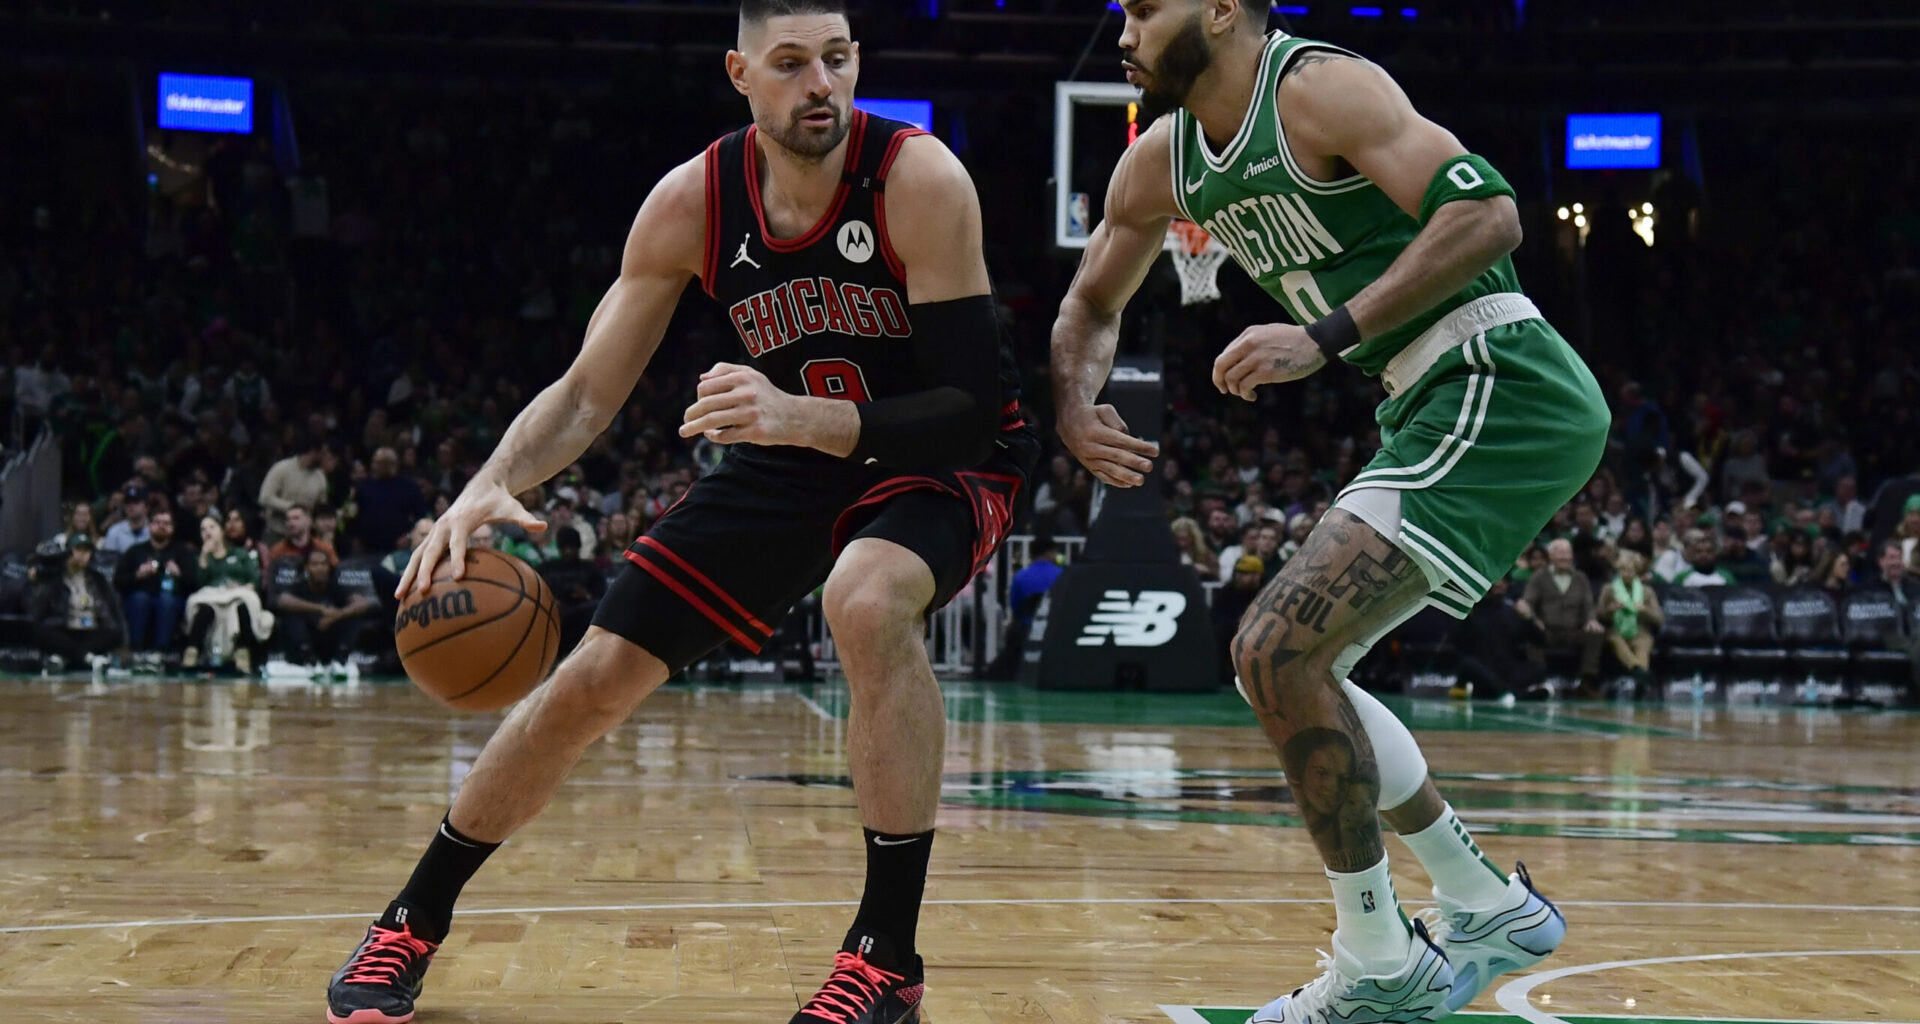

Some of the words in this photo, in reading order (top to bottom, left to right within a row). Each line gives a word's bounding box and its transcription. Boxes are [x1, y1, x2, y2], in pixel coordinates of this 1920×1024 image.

[1243, 155, 1280, 180] Amica
[1446, 161, 1485, 190] 0
[1202, 192, 1345, 279] BOSTON
[729, 276, 912, 358] CHICAGO
